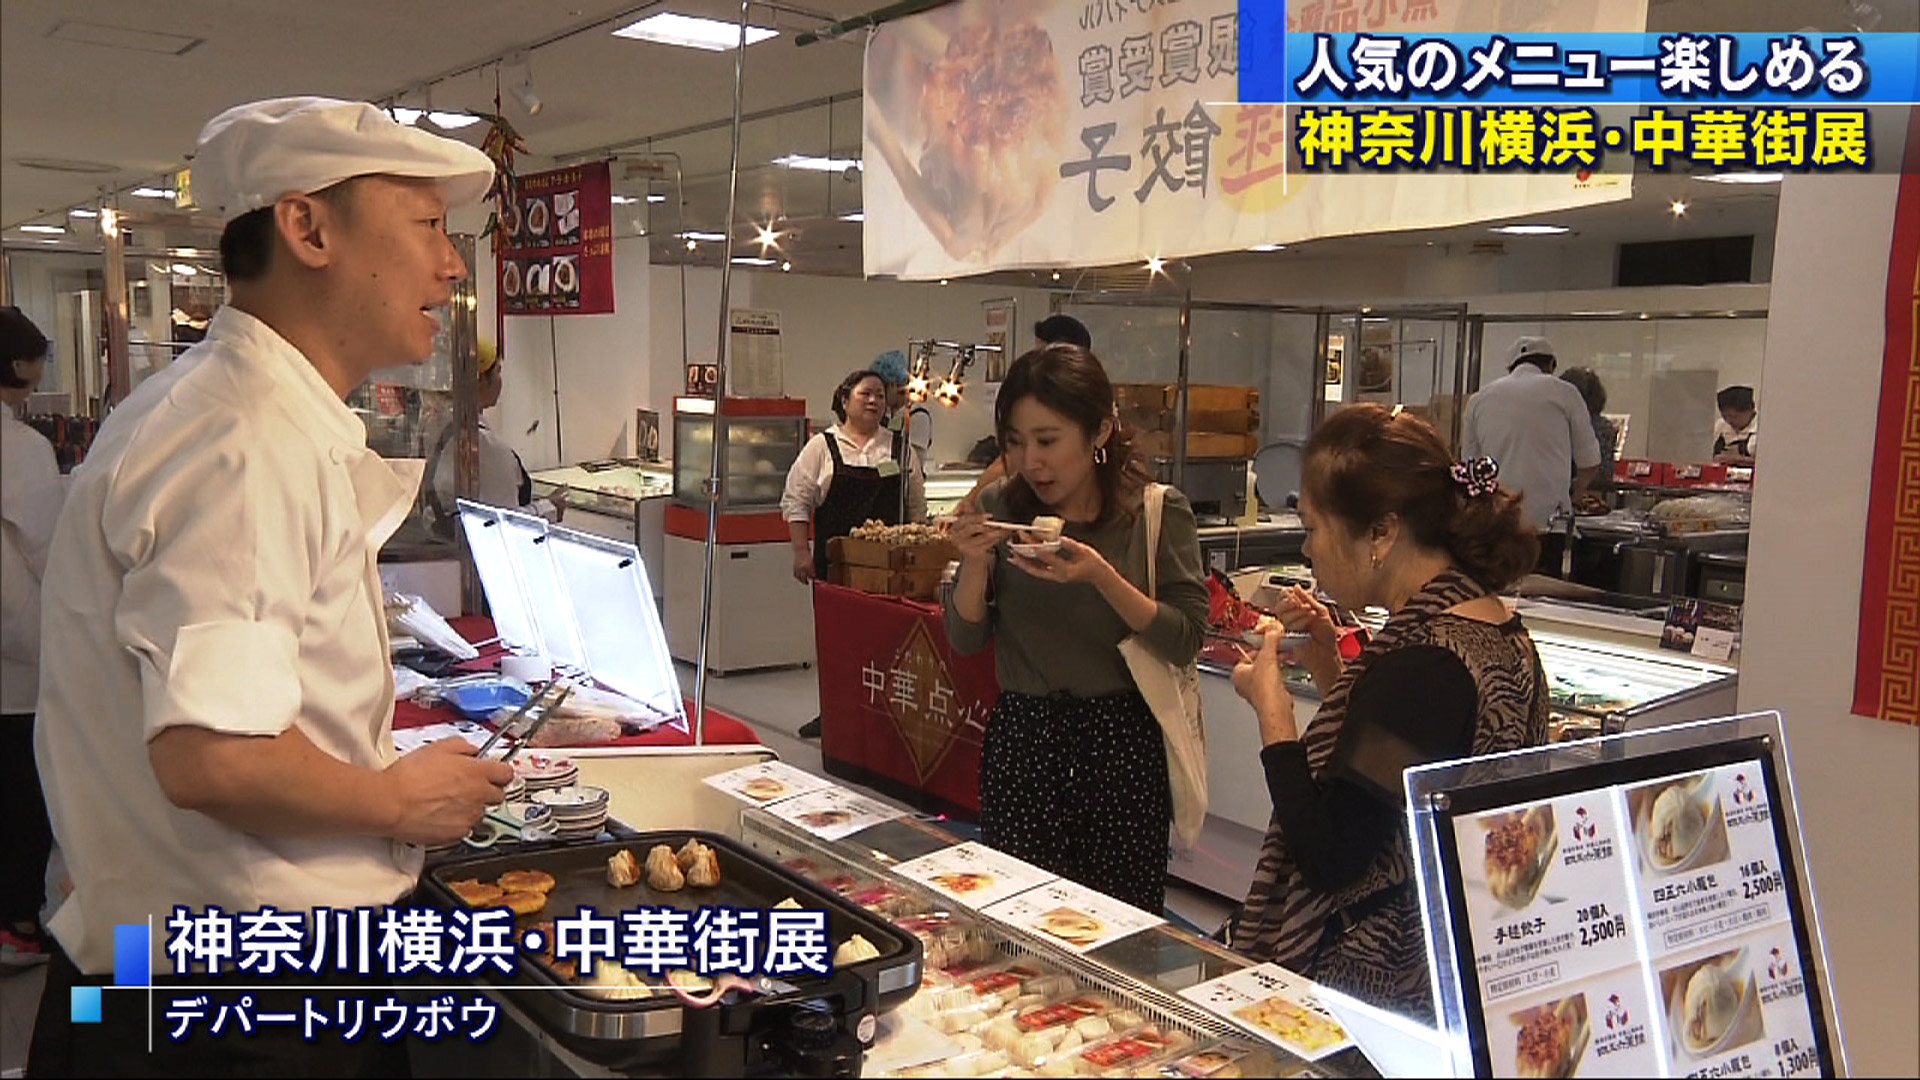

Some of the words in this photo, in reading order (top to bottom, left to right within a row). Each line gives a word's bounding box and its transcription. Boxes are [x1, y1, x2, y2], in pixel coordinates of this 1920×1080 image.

[862, 659, 988, 738] 中華点心
[1743, 875, 1783, 900] 2,500円
[1579, 919, 1626, 947] 2,500円
